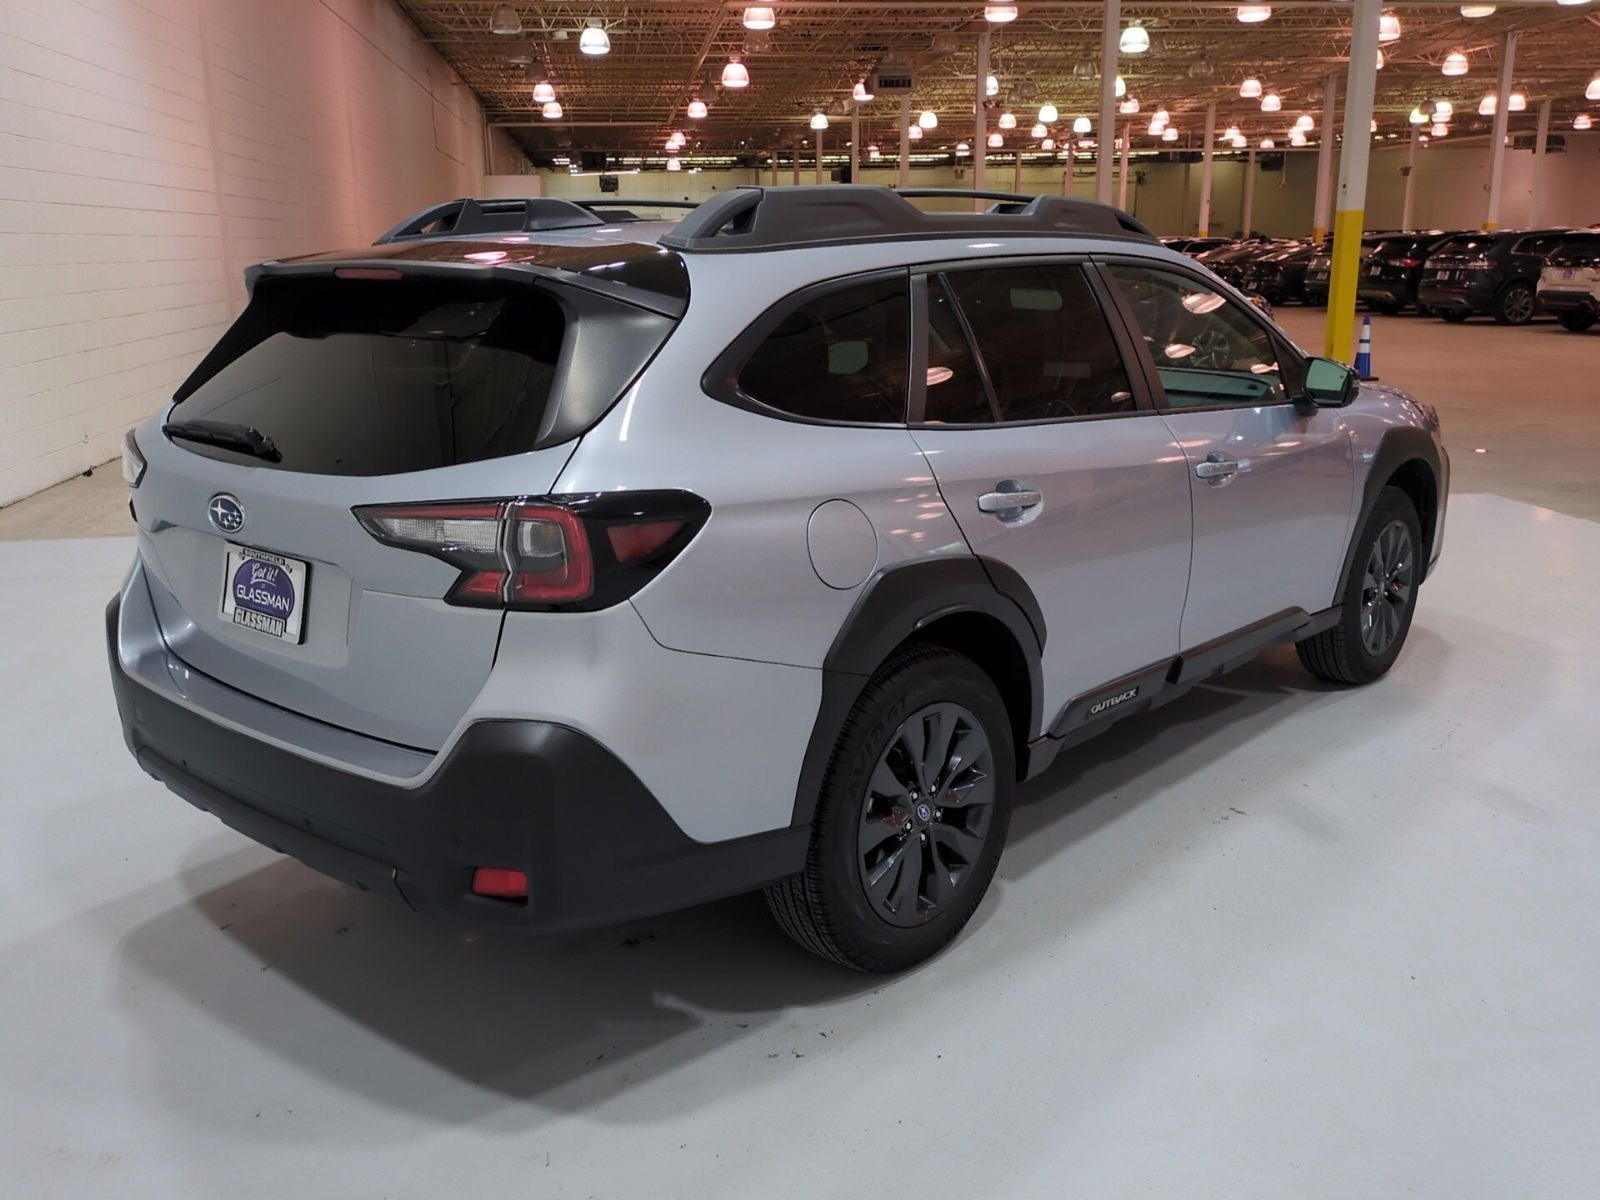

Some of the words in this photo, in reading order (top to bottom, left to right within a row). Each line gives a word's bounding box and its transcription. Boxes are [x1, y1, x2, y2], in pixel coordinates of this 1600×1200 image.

[244, 549, 284, 565] SOUTHFIELD
[251, 562, 265, 580] Got
[236, 584, 290, 612] GLASSMAN
[234, 608, 284, 637] GLASSMAN
[1091, 688, 1137, 714] OUTBACK
